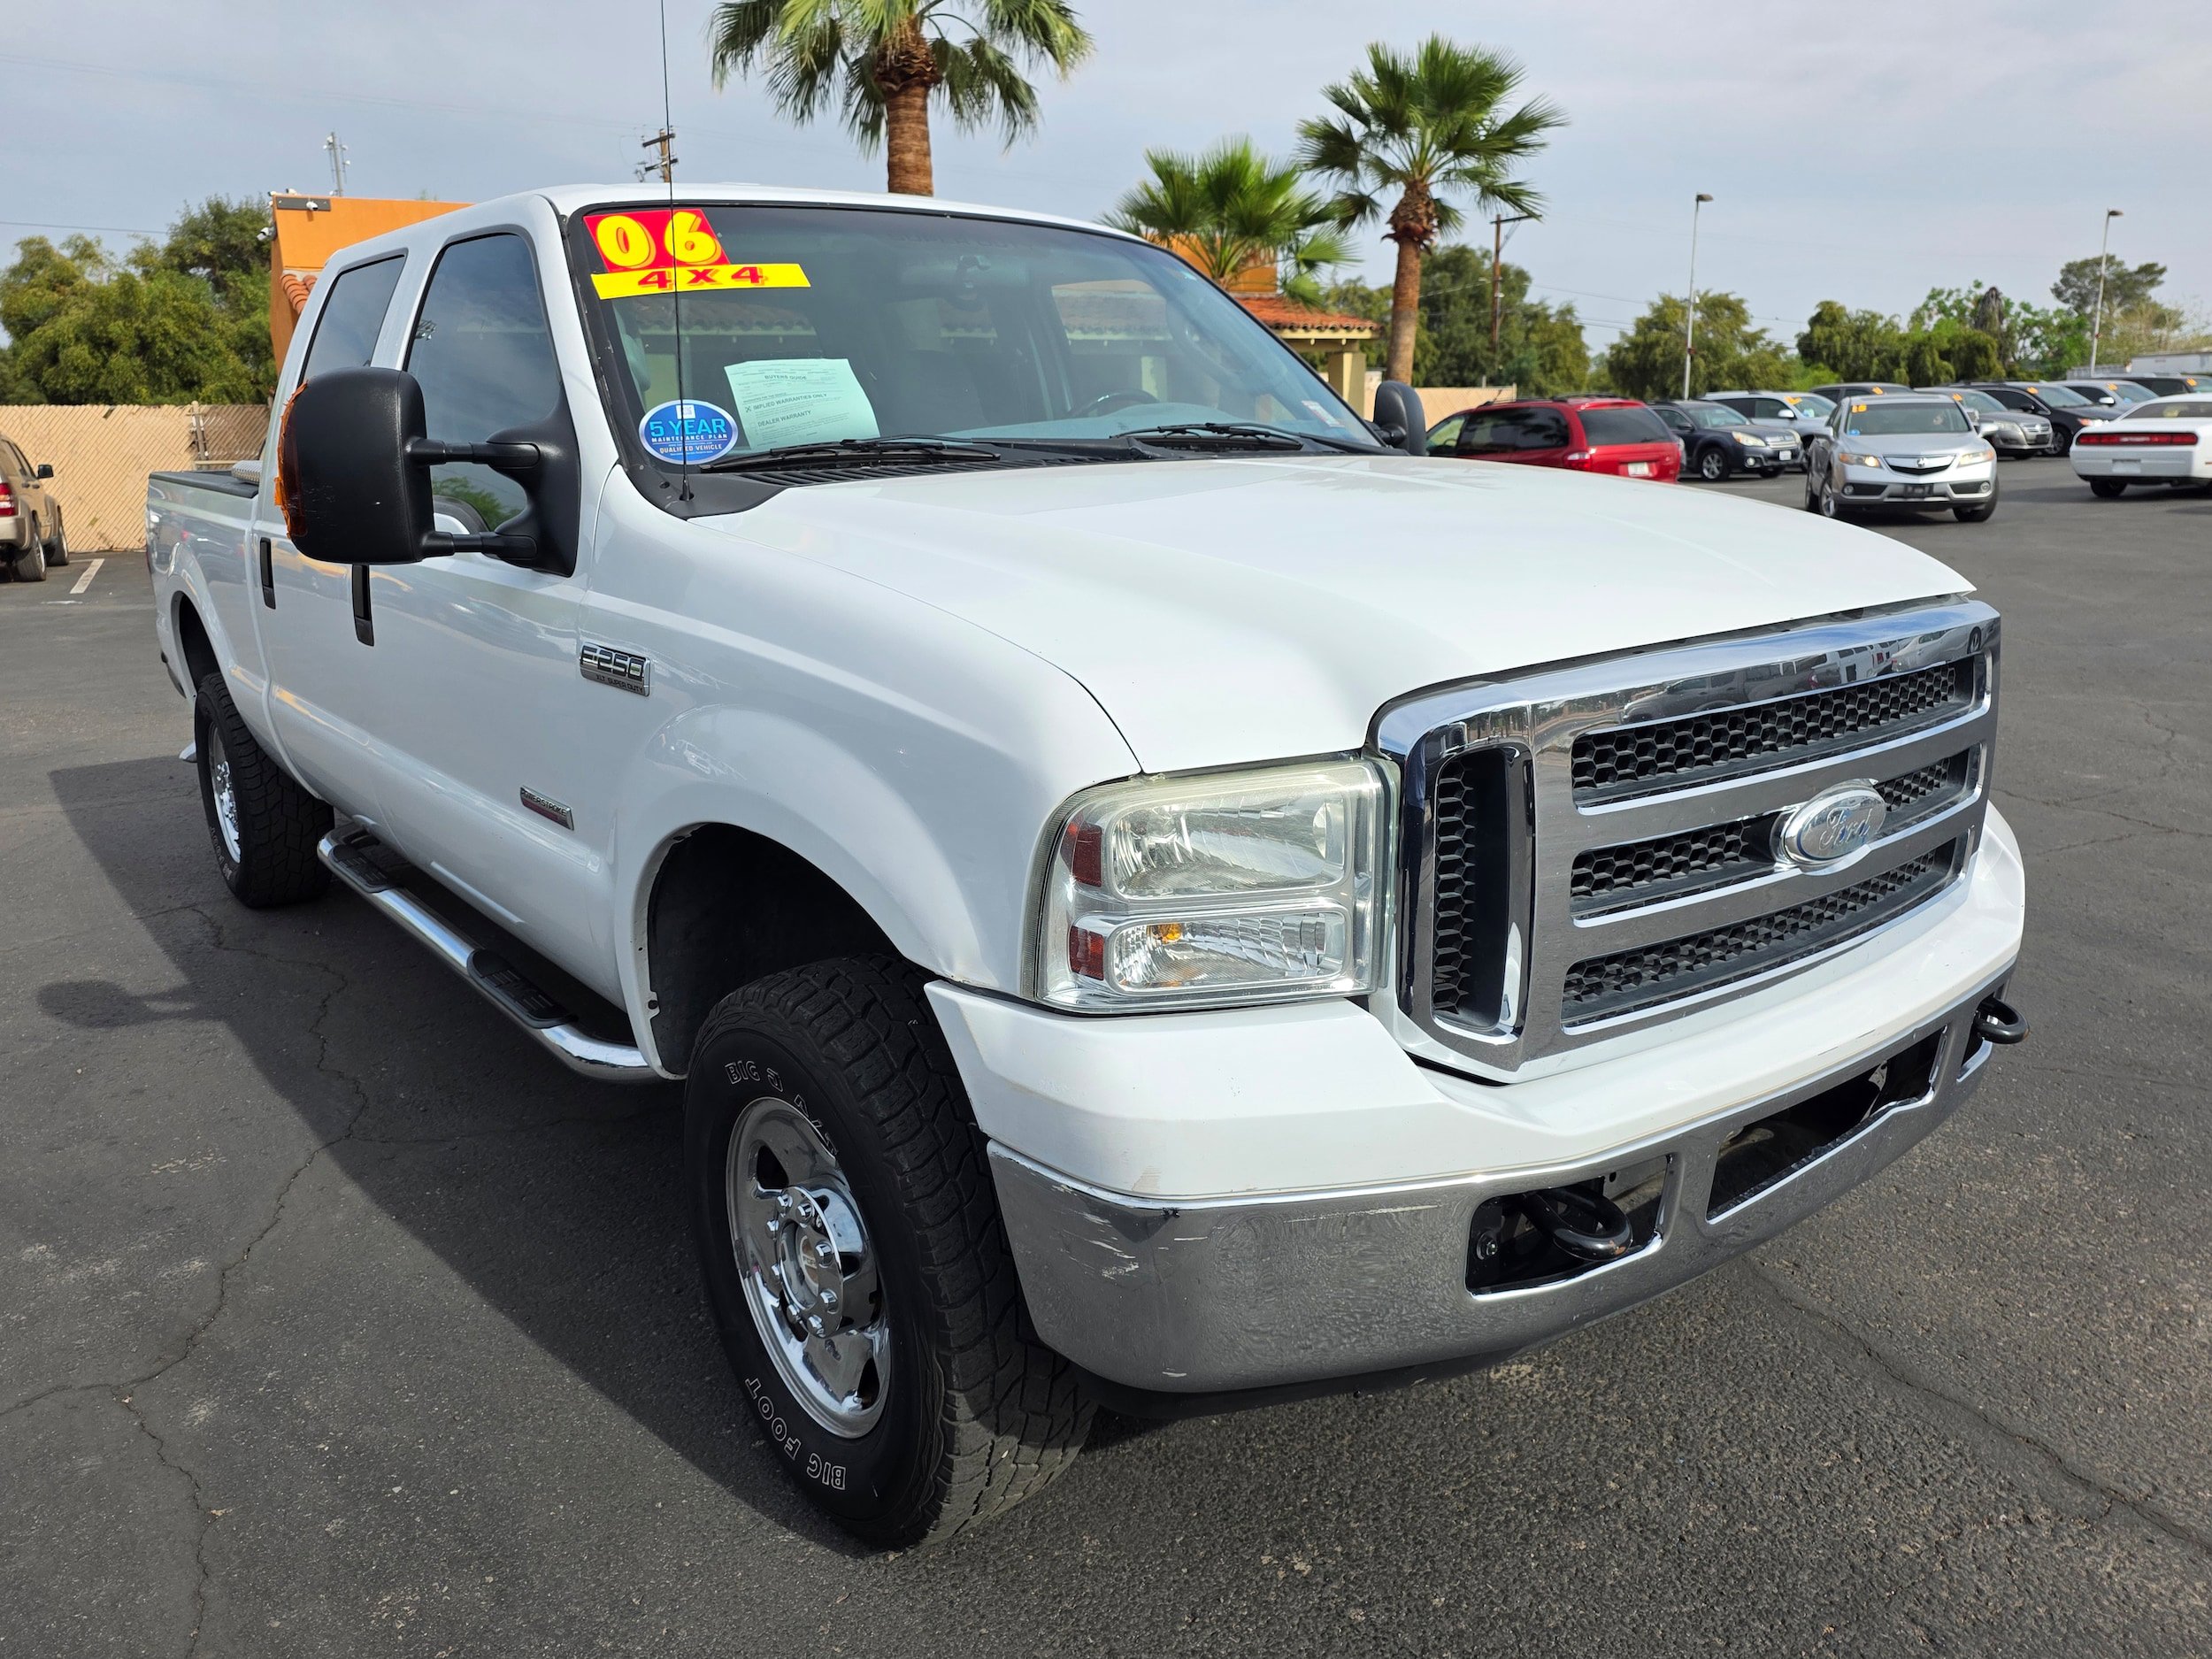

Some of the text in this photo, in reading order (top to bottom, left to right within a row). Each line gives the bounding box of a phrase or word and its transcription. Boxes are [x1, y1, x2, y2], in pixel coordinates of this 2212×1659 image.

[596, 211, 722, 269] 06
[753, 401, 775, 411] IMPLIED
[776, 395, 812, 406] WARRANTIES
[649, 418, 726, 437] 5 YEAR
[757, 410, 812, 427] DEALER WARRANTY
[659, 445, 694, 454] QUALIFED
[1818, 803, 1873, 851] Ford
[725, 1060, 761, 1085] BIG
[744, 1378, 847, 1491] BIG FOOT
